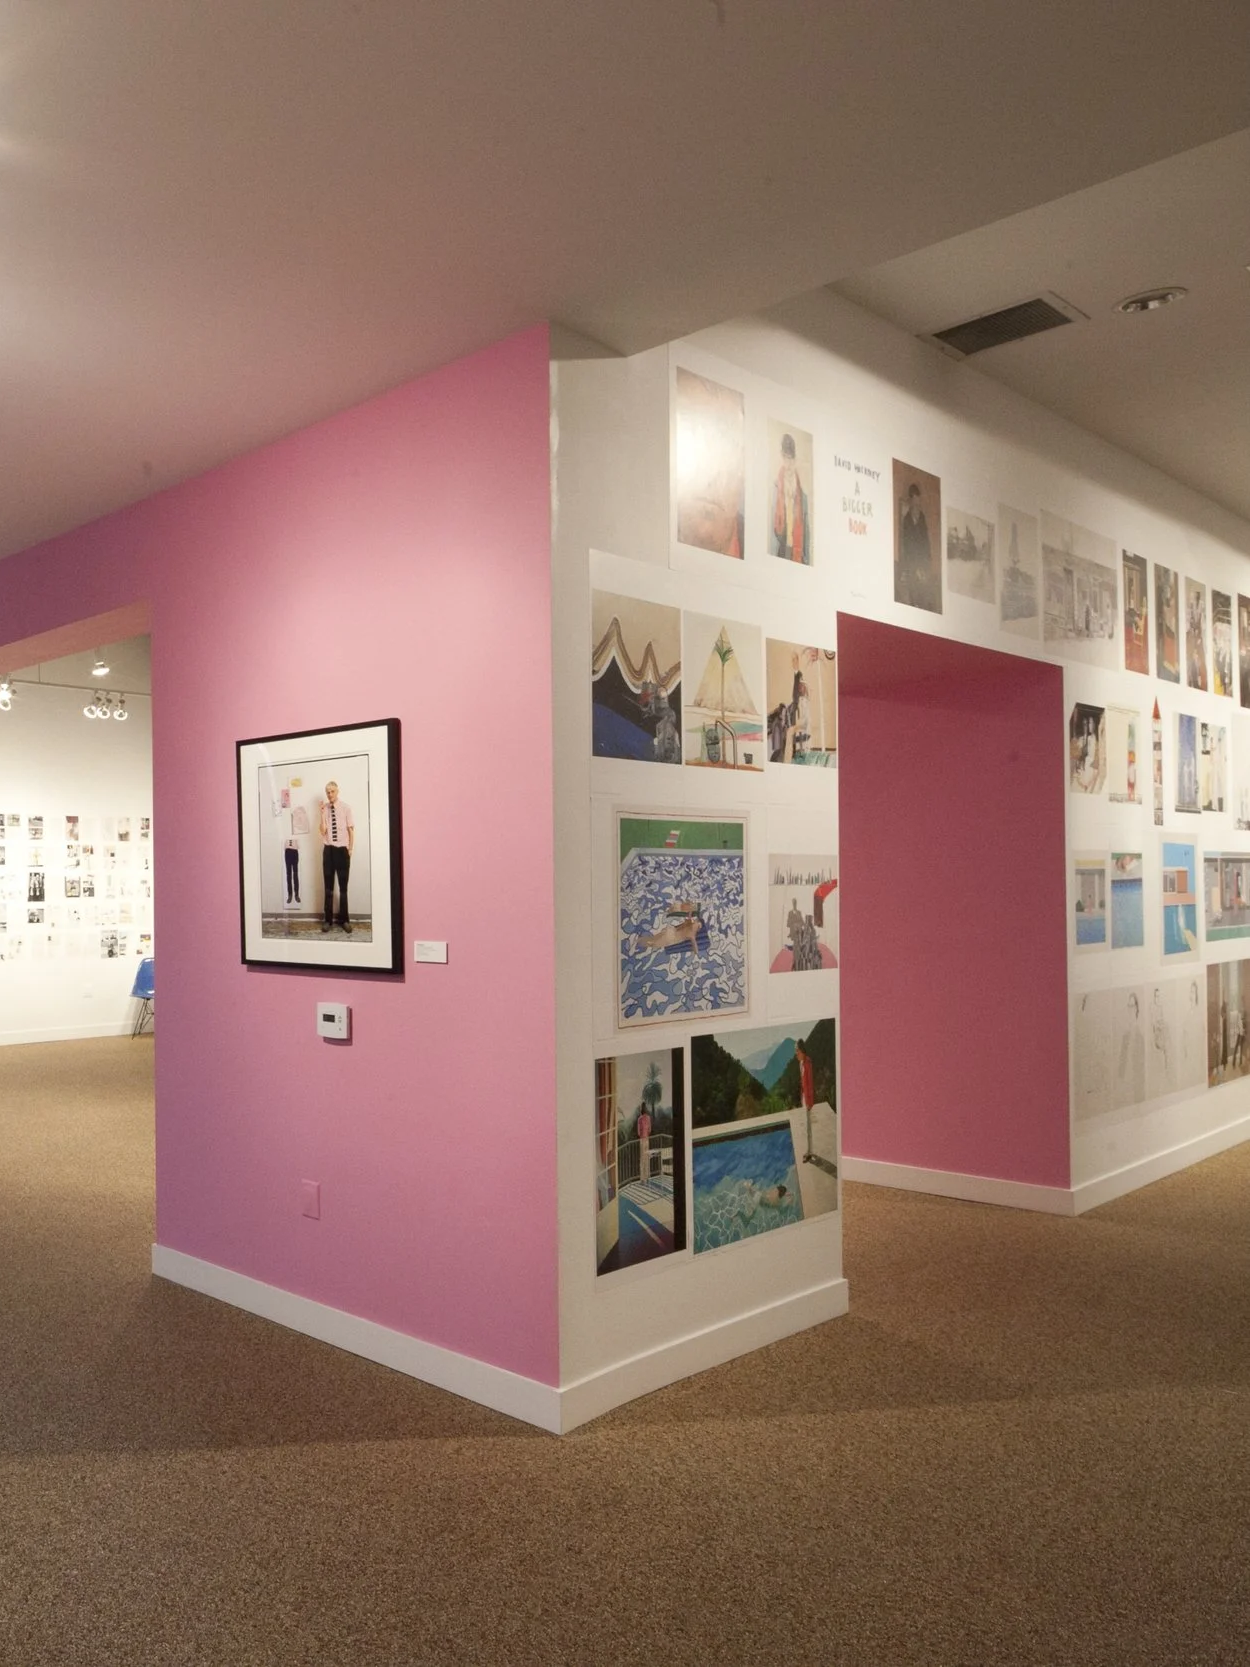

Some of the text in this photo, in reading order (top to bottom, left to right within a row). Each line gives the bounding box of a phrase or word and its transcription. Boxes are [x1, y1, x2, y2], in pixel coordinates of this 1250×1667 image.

[854, 481, 861, 496] A
[842, 496, 874, 518] BIGGER
[848, 517, 868, 536] BOOK
